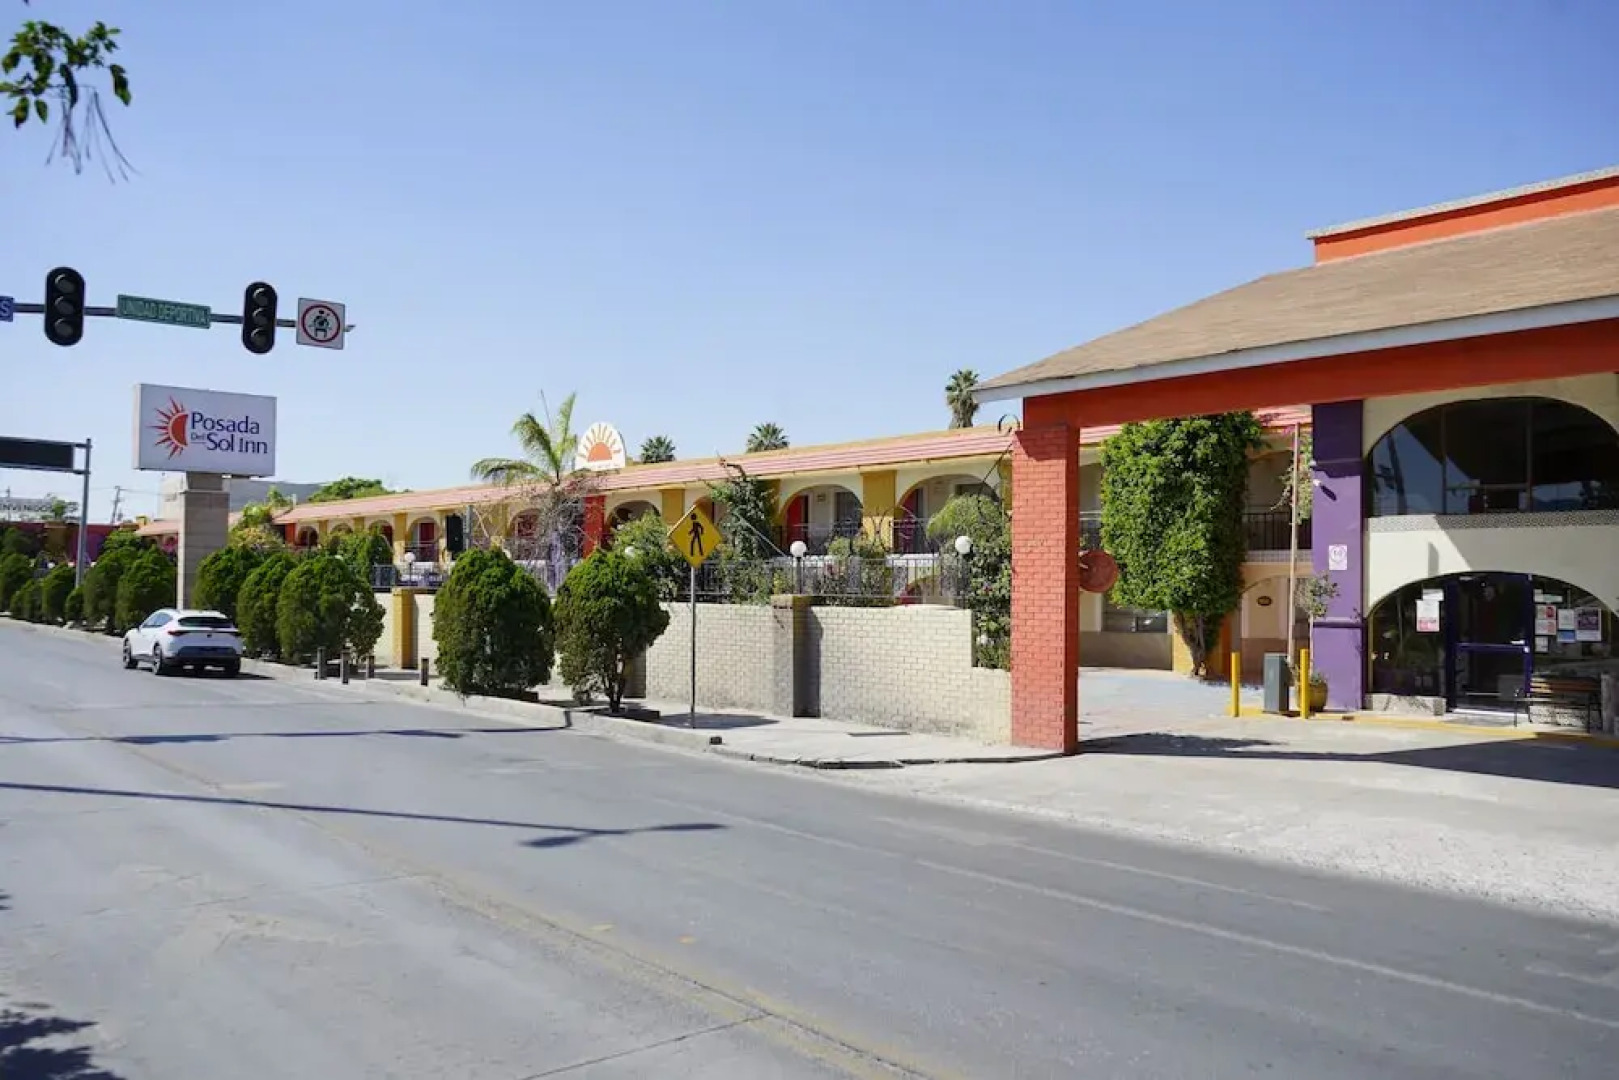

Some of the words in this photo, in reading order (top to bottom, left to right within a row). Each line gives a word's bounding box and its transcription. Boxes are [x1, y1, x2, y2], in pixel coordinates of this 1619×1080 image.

[122, 298, 158, 319] UNIDAD
[158, 303, 207, 325] DEPORTIVA
[191, 411, 260, 434] Posada
[191, 432, 204, 441] Del
[206, 432, 234, 452] Sol
[238, 437, 268, 454] Inn
